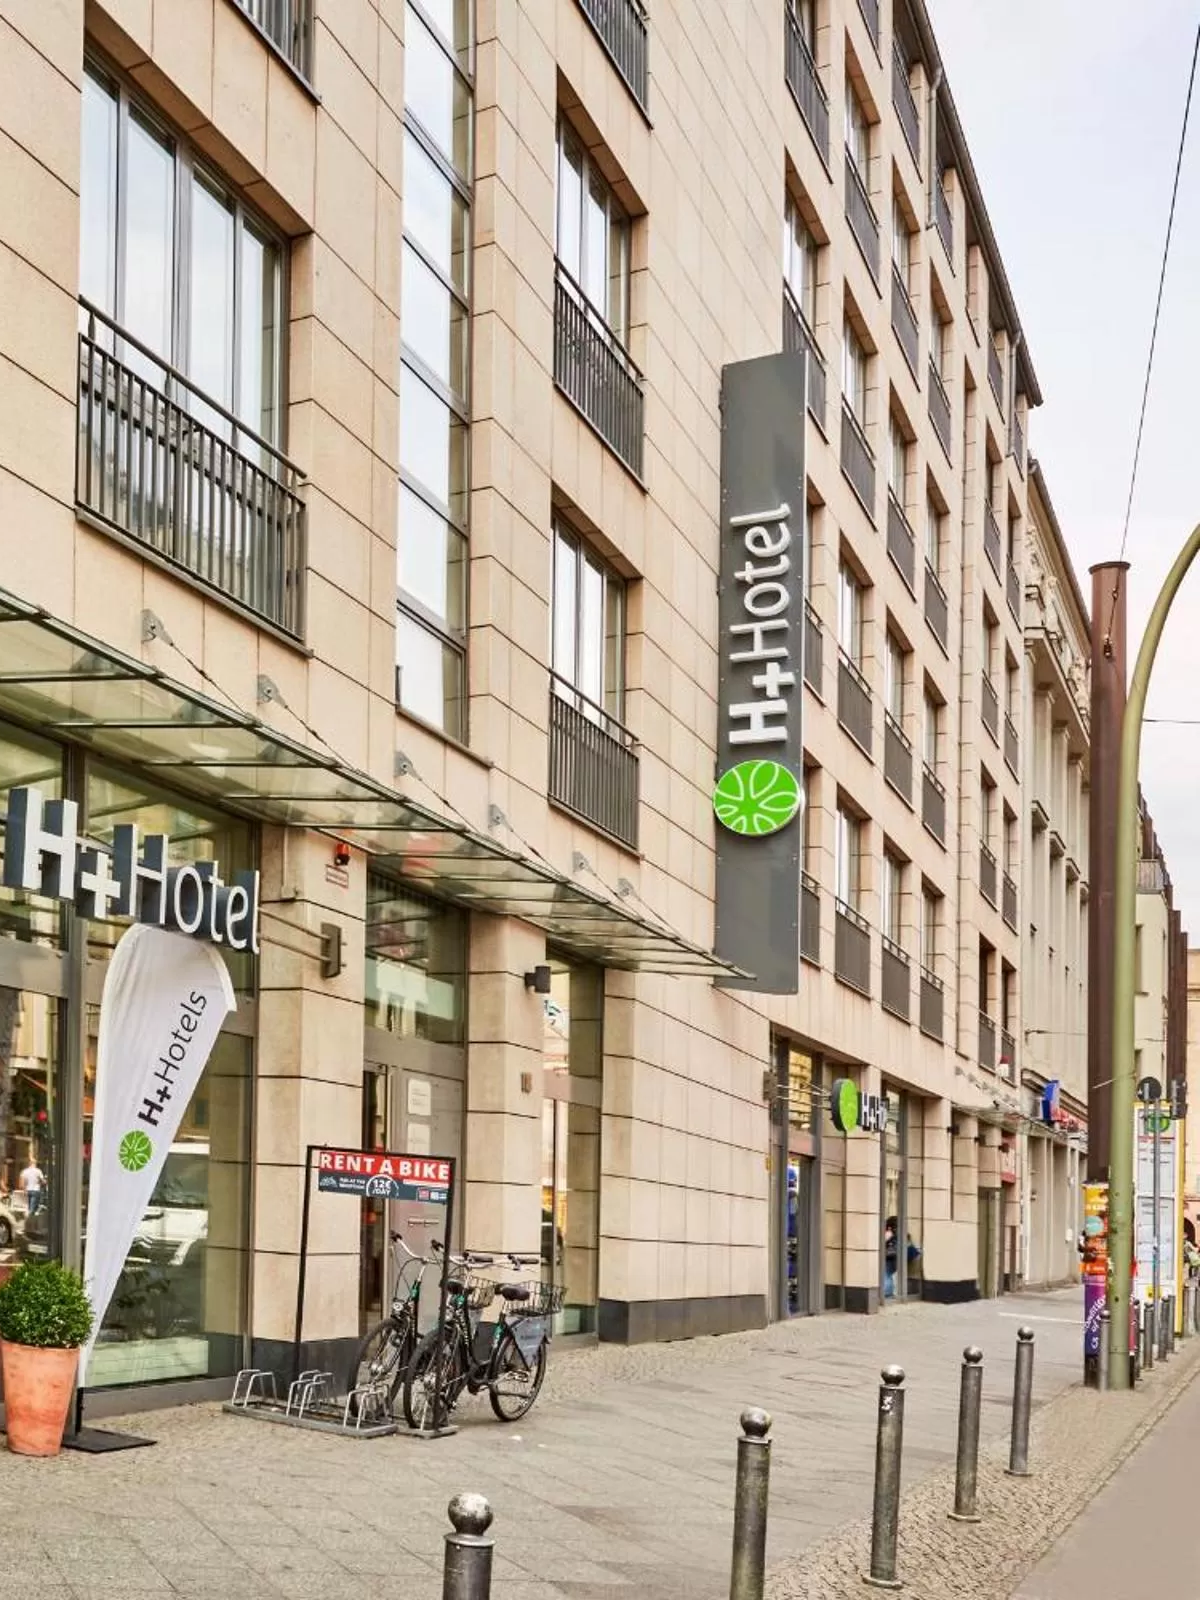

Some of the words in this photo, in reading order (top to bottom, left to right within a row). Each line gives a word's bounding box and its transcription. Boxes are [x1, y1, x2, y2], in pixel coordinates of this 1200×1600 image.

[728, 502, 796, 744] H+Hotel
[6, 787, 260, 955] H+Hotel
[137, 991, 207, 1127] H+Hotels
[320, 1153, 375, 1173] RENT
[379, 1158, 395, 1176] A
[400, 1160, 450, 1180] BIKE
